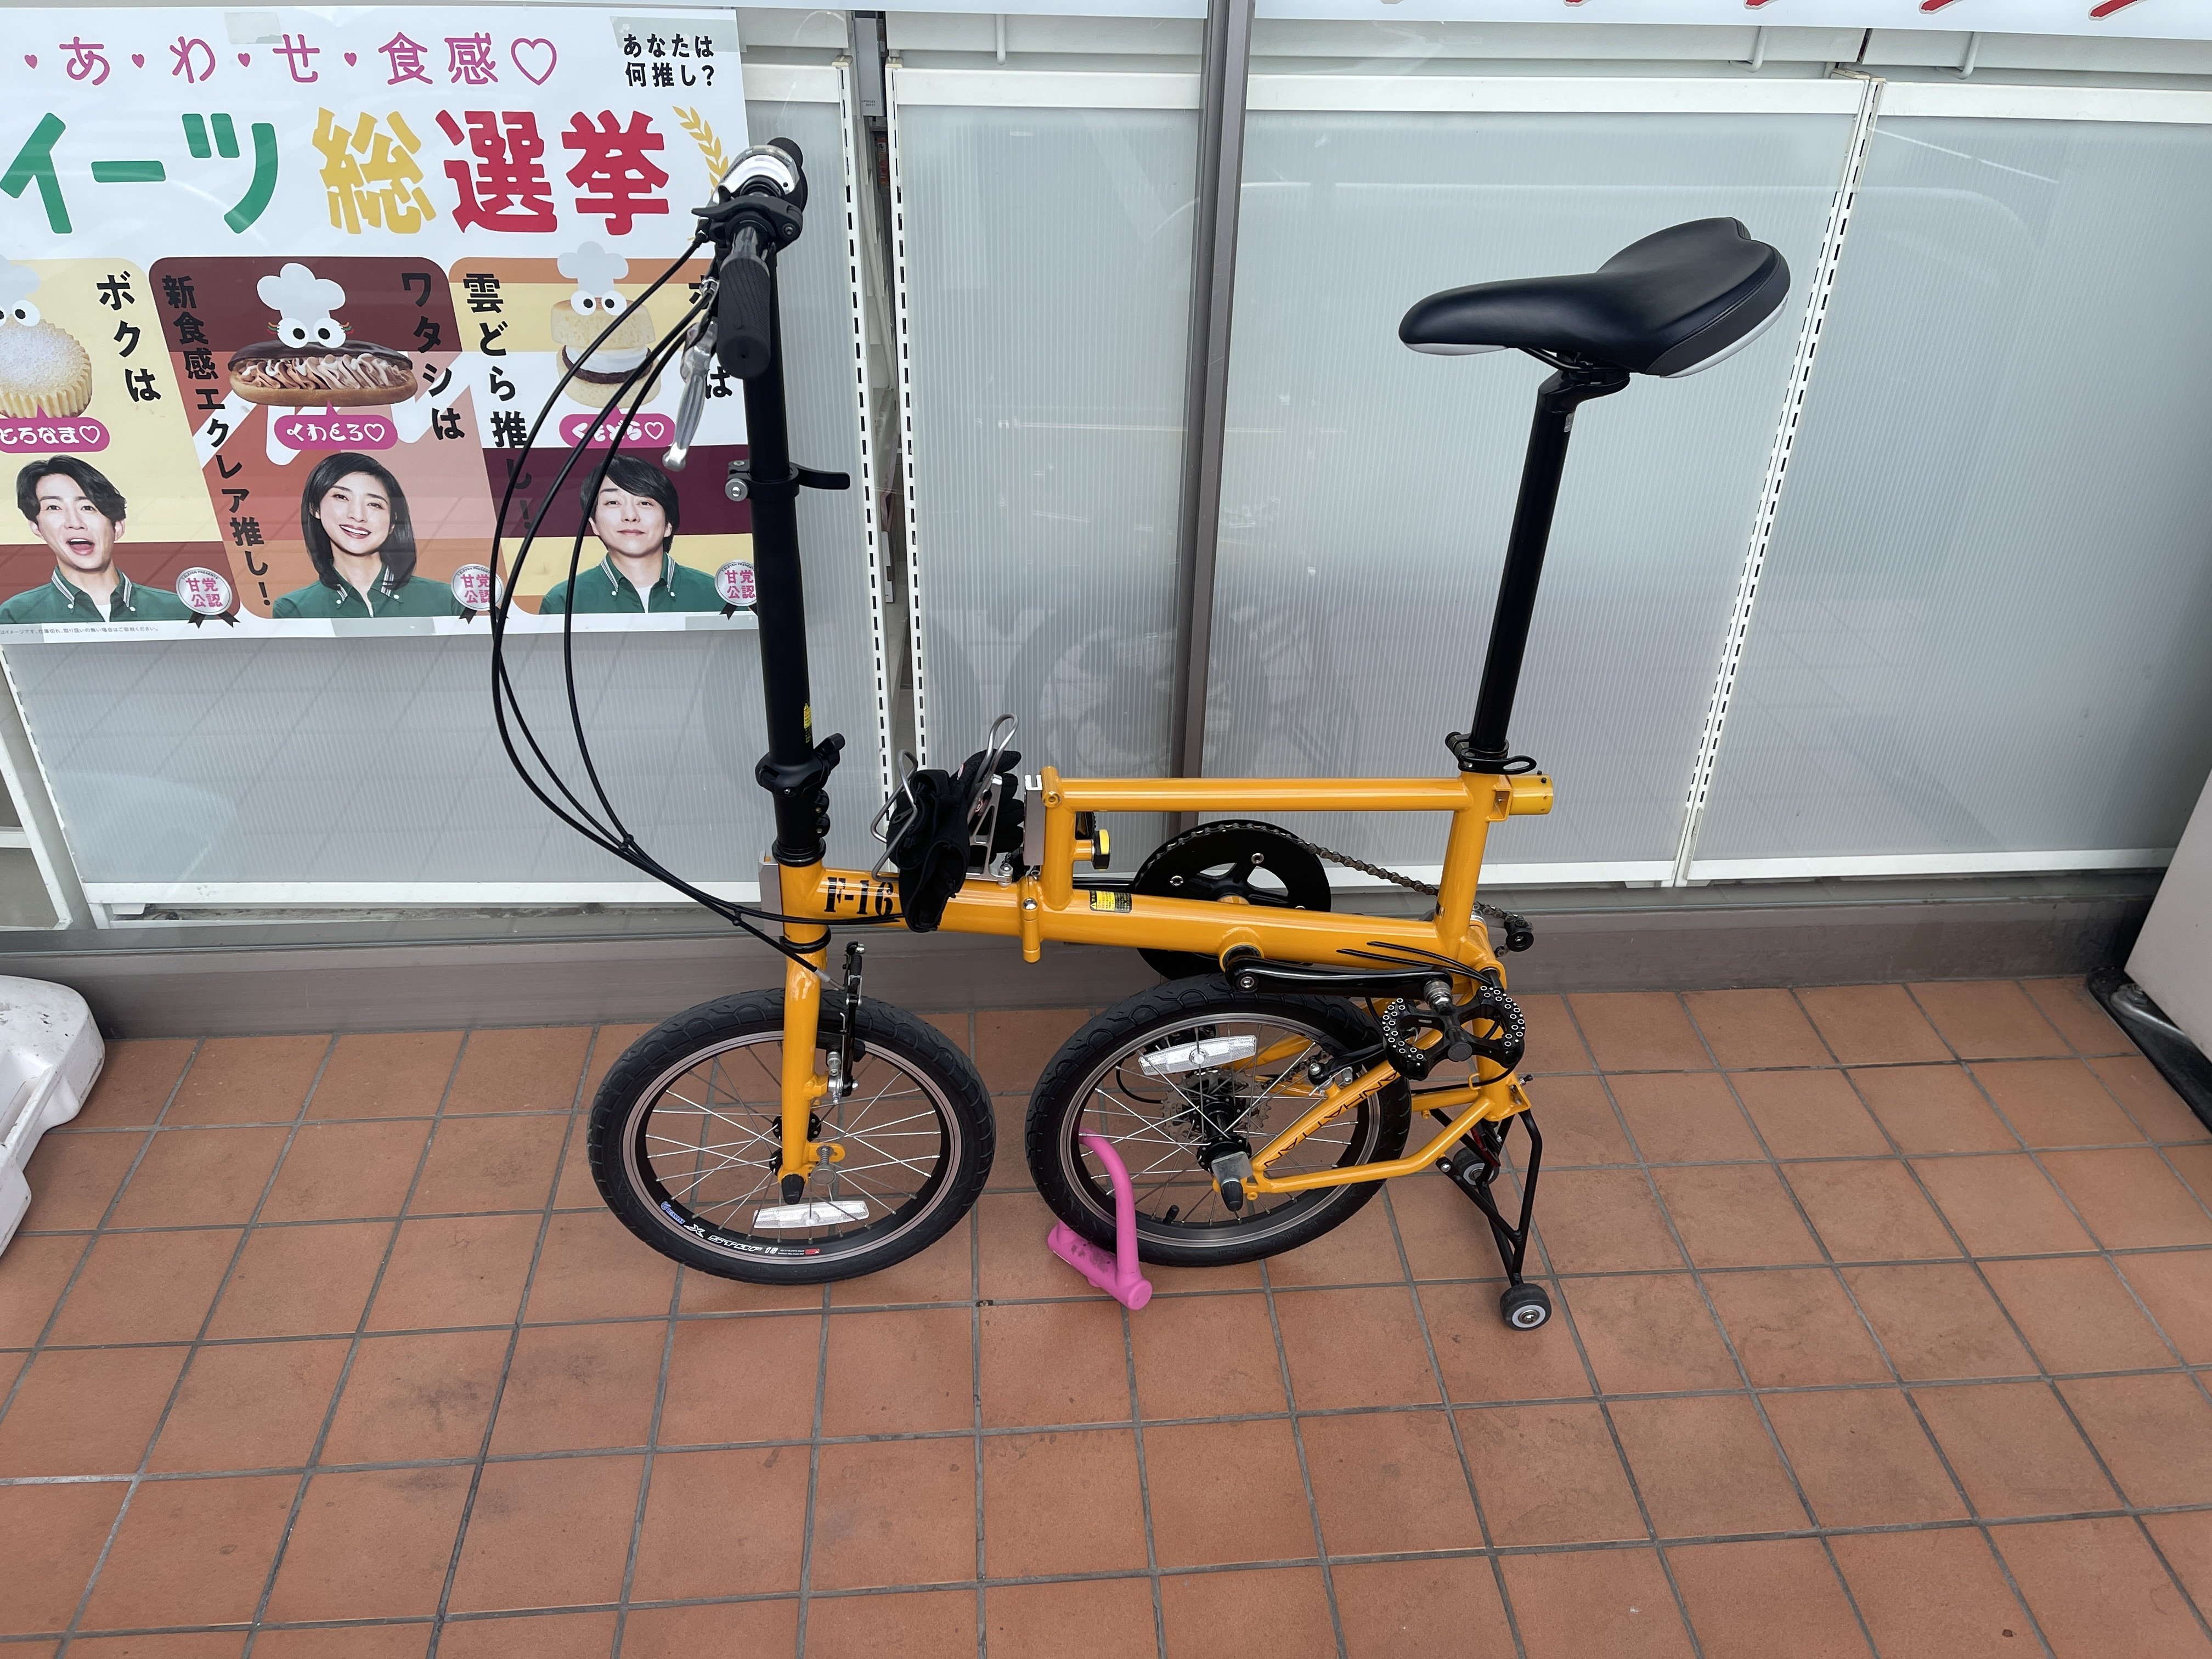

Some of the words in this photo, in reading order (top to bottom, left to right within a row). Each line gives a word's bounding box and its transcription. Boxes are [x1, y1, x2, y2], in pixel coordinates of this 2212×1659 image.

[623, 33, 714, 58] あなたは
[625, 62, 714, 88] 何推し?
[0, 106, 669, 235] イーツ総選挙
[97, 270, 161, 402] ボクは
[402, 273, 465, 440] ワタシは
[185, 578, 218, 592] 甘党
[460, 574, 490, 588] 甘党
[724, 569, 754, 584] 甘党
[191, 594, 223, 607] 公認
[726, 585, 755, 599] 公認
[823, 876, 894, 916] F-16
[1263, 1071, 1397, 1167] ANHATTAN
